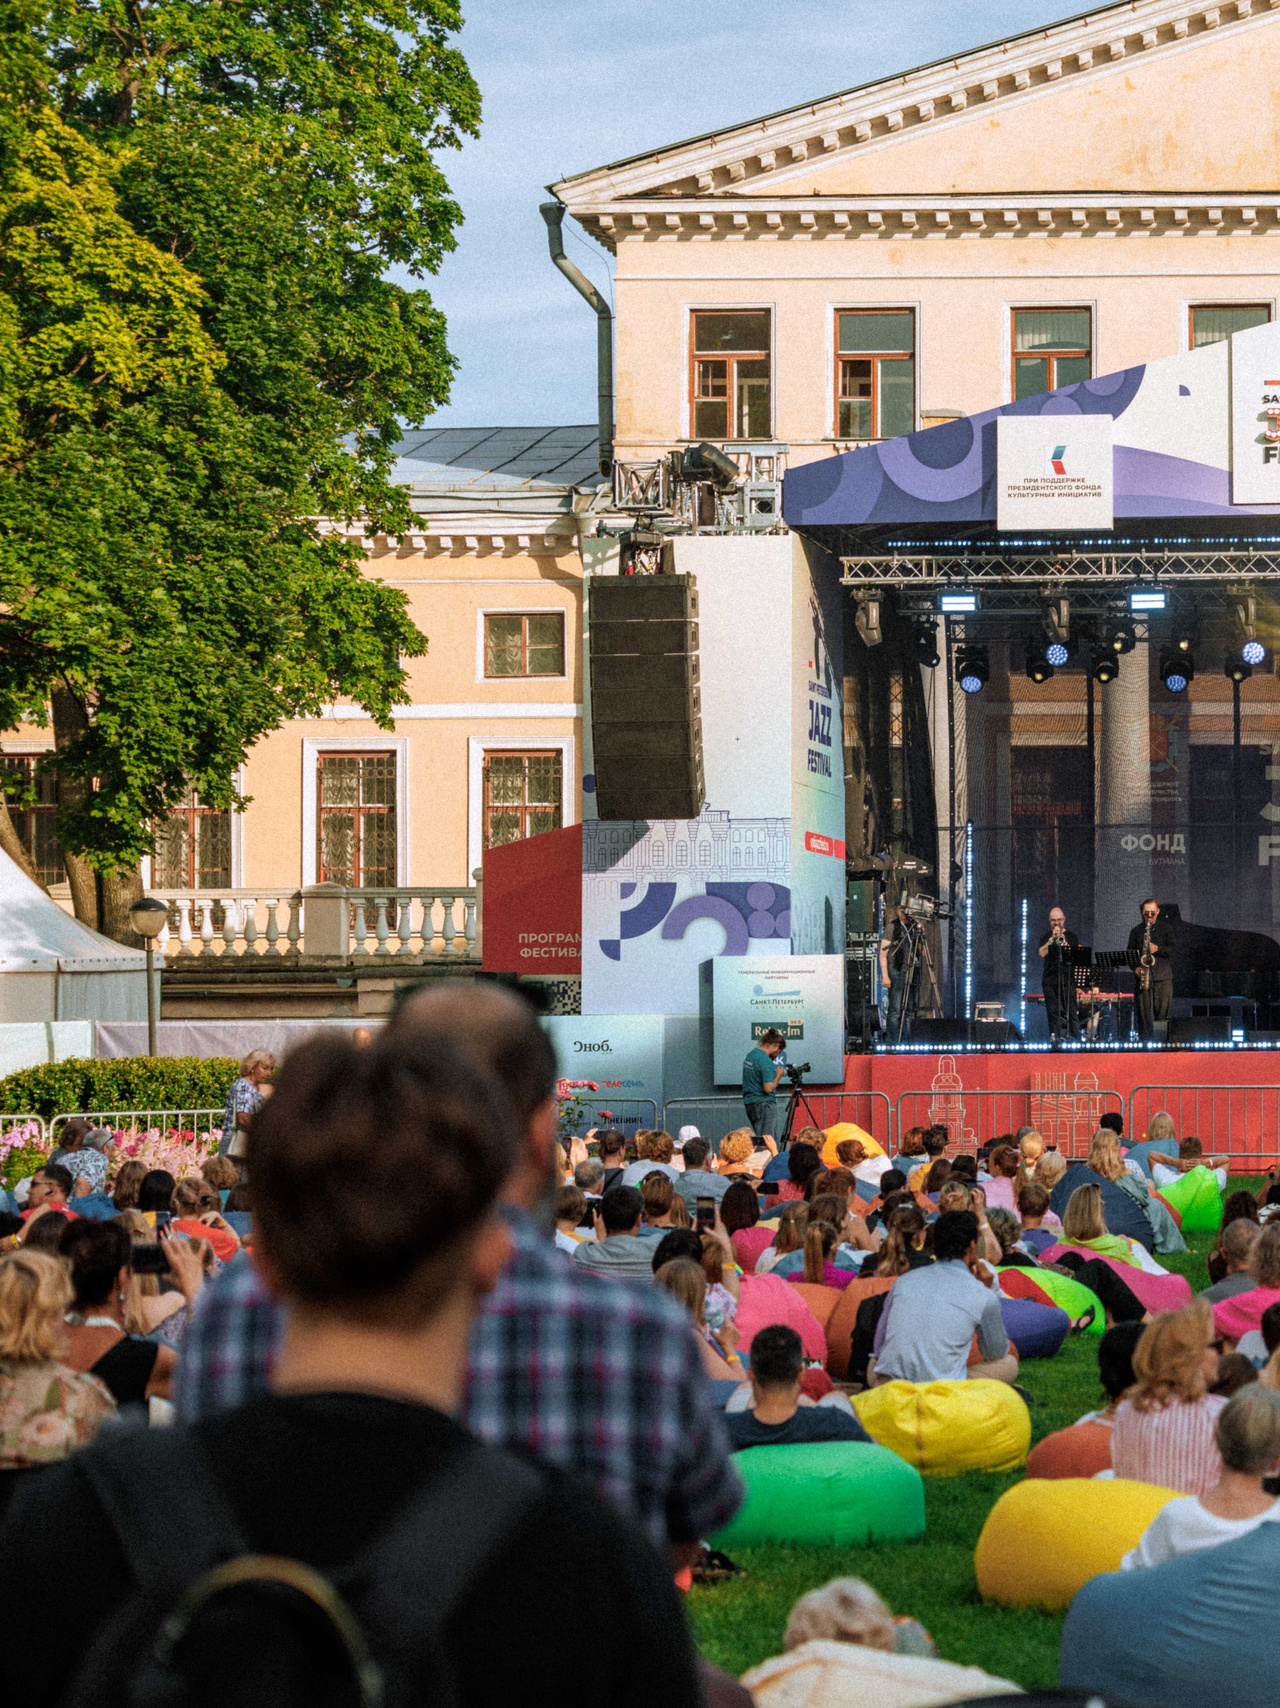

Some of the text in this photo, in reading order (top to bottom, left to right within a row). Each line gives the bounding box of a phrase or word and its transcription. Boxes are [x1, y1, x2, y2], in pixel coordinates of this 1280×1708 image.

[808, 699, 832, 748] JAZZ
[807, 748, 832, 778] FESTIVAL
[1120, 833, 1186, 854] ФОНД
